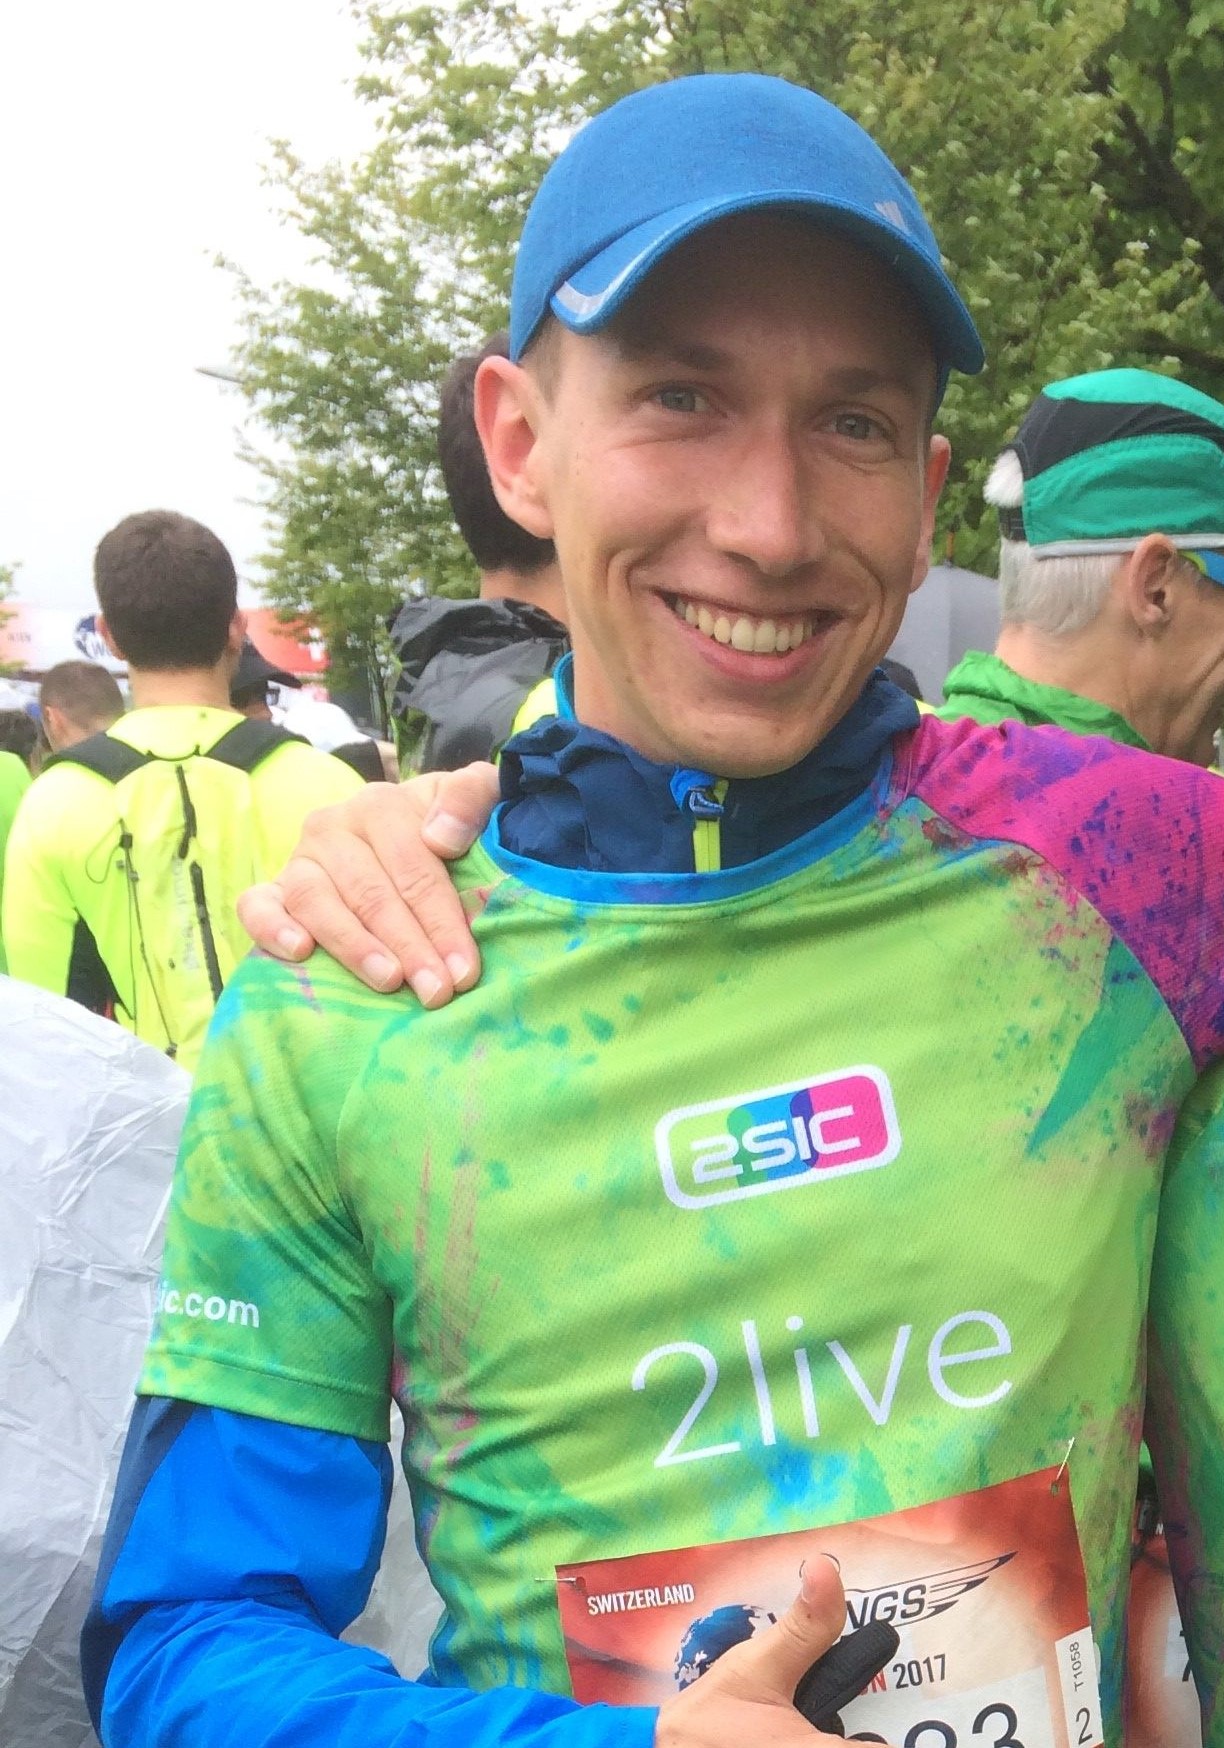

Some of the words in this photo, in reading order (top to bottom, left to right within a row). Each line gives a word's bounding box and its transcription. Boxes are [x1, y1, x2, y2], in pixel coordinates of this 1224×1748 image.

[158, 1280, 260, 1328] ic.com
[631, 1310, 1013, 1468] 2live
[587, 1584, 695, 1616] SWITZERLAND
[846, 1584, 927, 1630] NGS
[892, 1653, 947, 1690] 2017
[1075, 1707, 1093, 1745] 2
